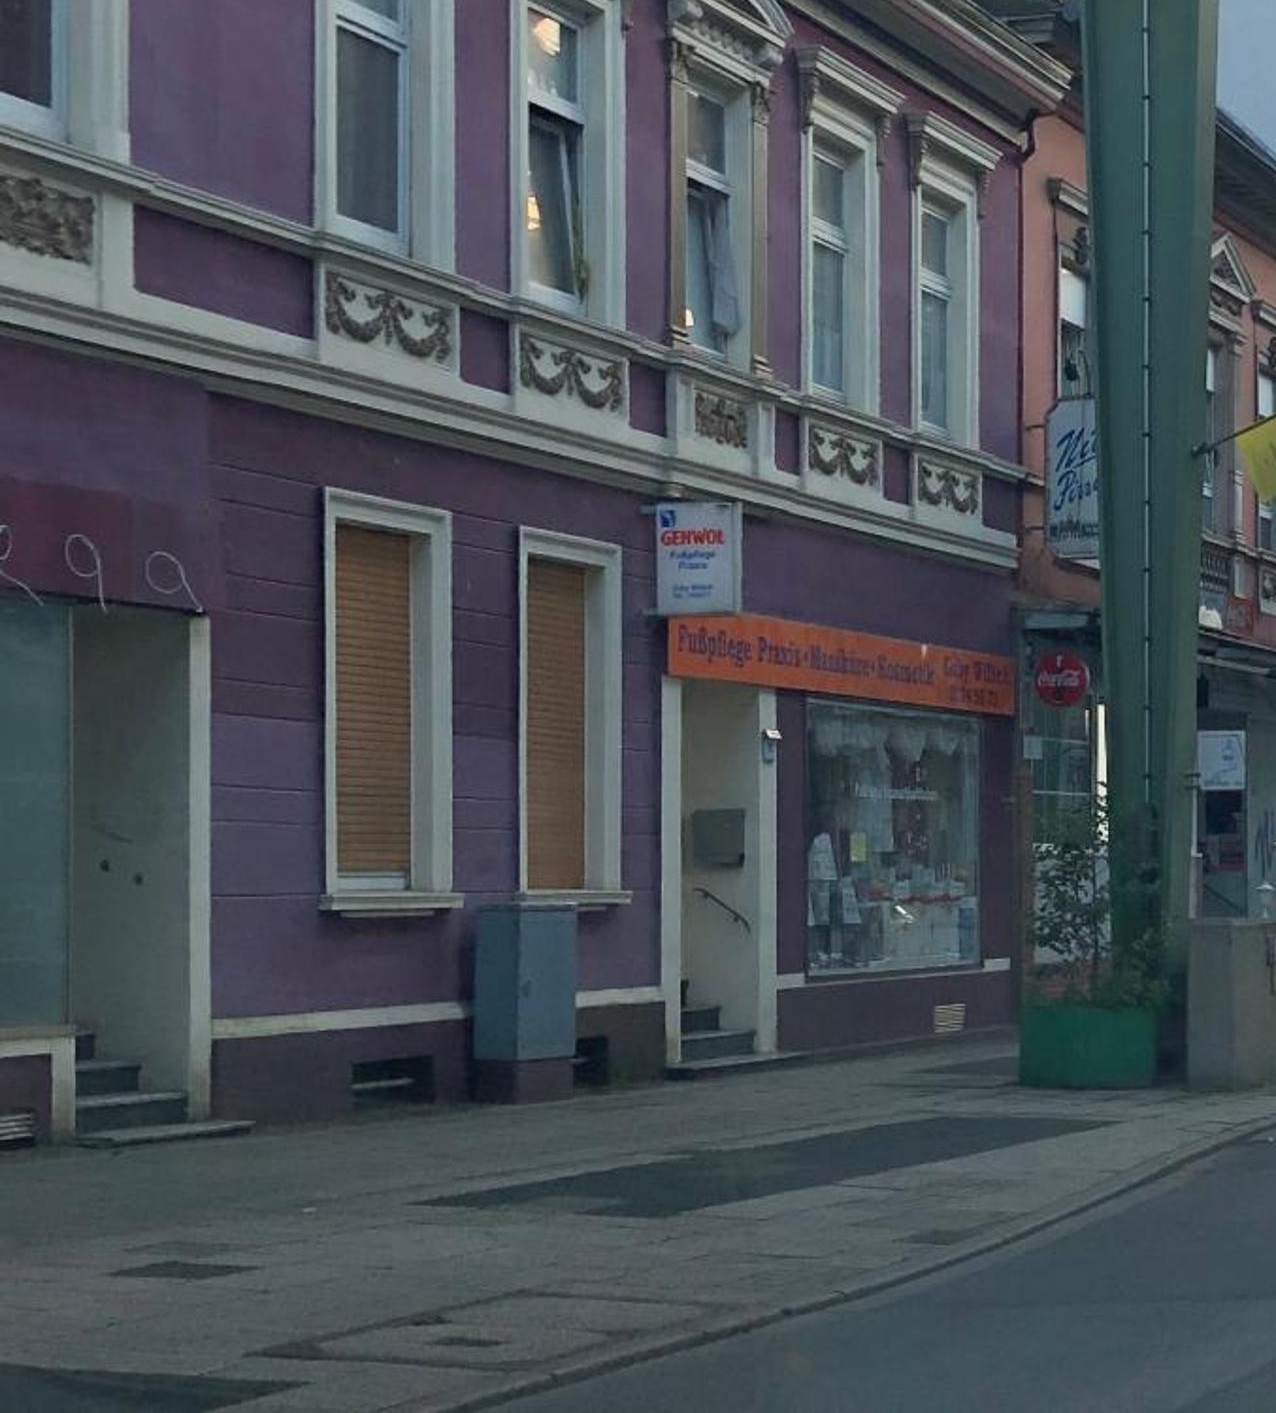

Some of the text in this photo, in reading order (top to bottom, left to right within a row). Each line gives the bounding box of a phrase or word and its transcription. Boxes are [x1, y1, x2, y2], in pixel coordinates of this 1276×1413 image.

[660, 528, 726, 546] GEHWOL
[678, 624, 753, 667] Fußpflege
[758, 636, 801, 667] Praxis
